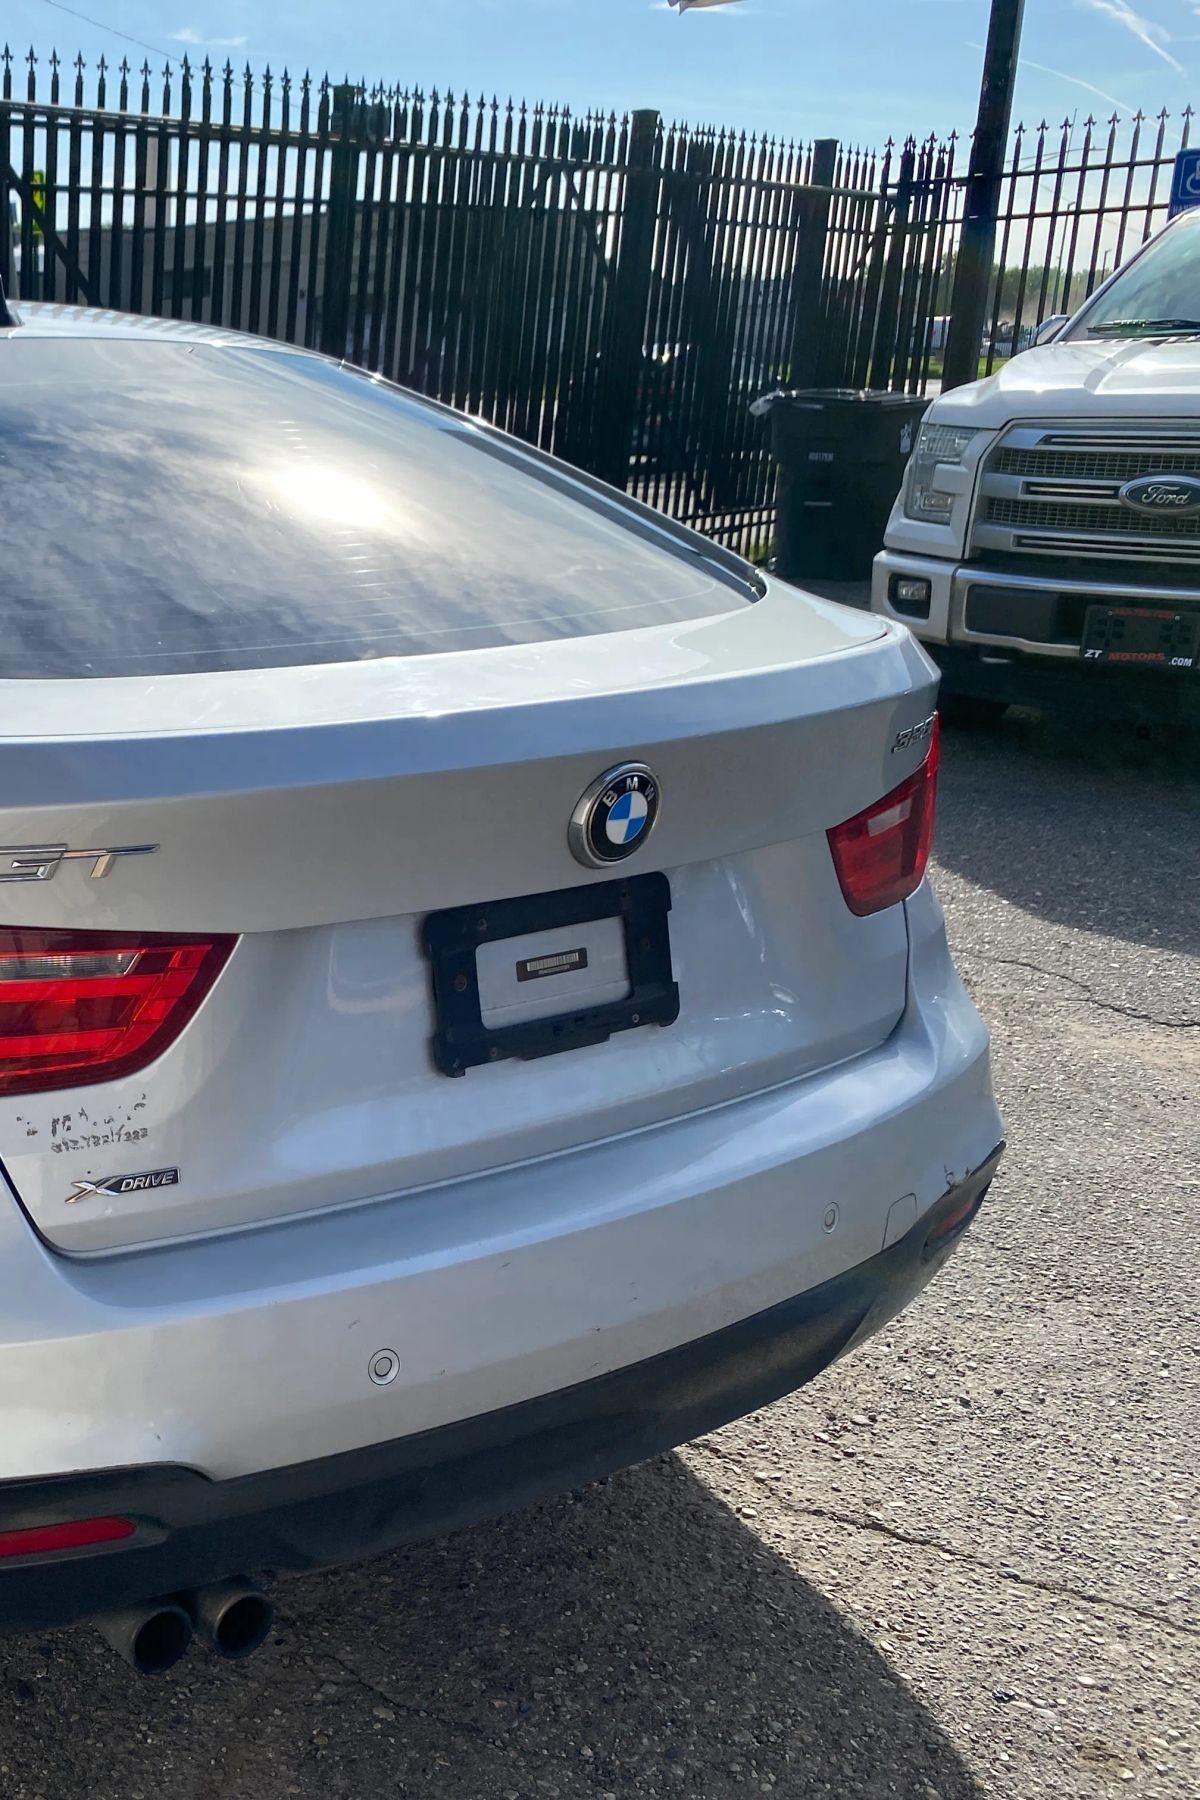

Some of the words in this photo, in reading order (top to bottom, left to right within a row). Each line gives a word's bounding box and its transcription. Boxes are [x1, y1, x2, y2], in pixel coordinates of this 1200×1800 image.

[1141, 484, 1192, 504] Ford
[1084, 649, 1103, 659] ZT
[1108, 651, 1167, 662] MOTORS
[1168, 656, 1193, 667] .COM
[602, 776, 656, 807] BMW
